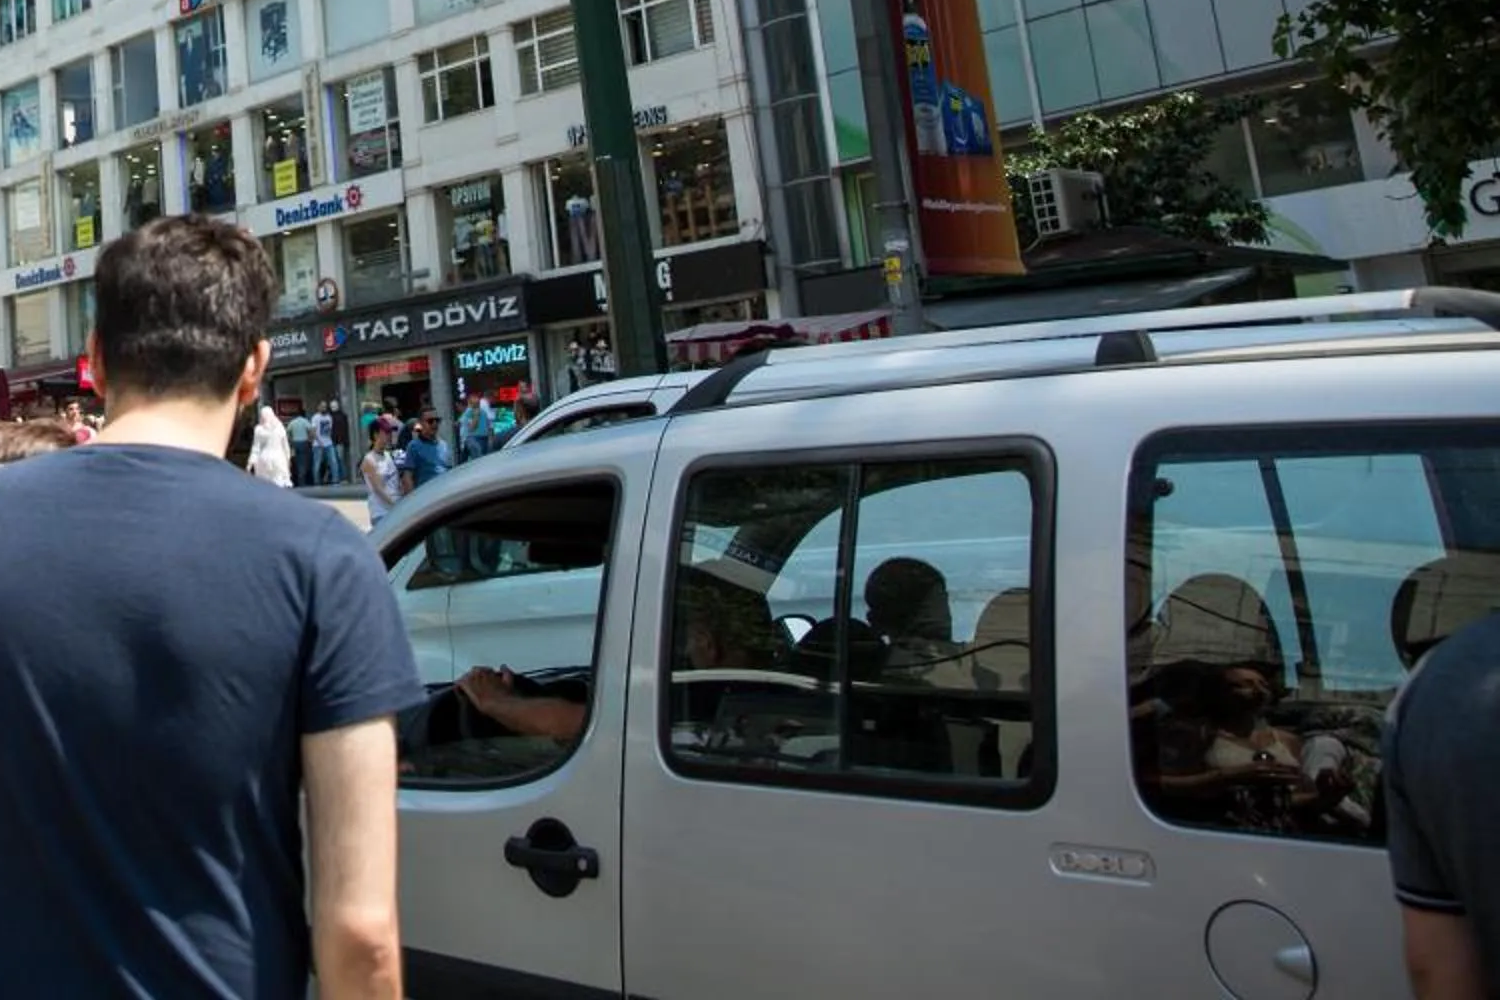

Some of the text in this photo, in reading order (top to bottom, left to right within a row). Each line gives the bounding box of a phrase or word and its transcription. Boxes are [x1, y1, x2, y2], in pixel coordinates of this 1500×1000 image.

[276, 193, 343, 227] DenizBank
[15, 264, 61, 289] DenizBank
[353, 315, 409, 341] TAÇ
[423, 296, 519, 331] DÖVİZ
[458, 344, 527, 370] TAÇ DÖVİZ
